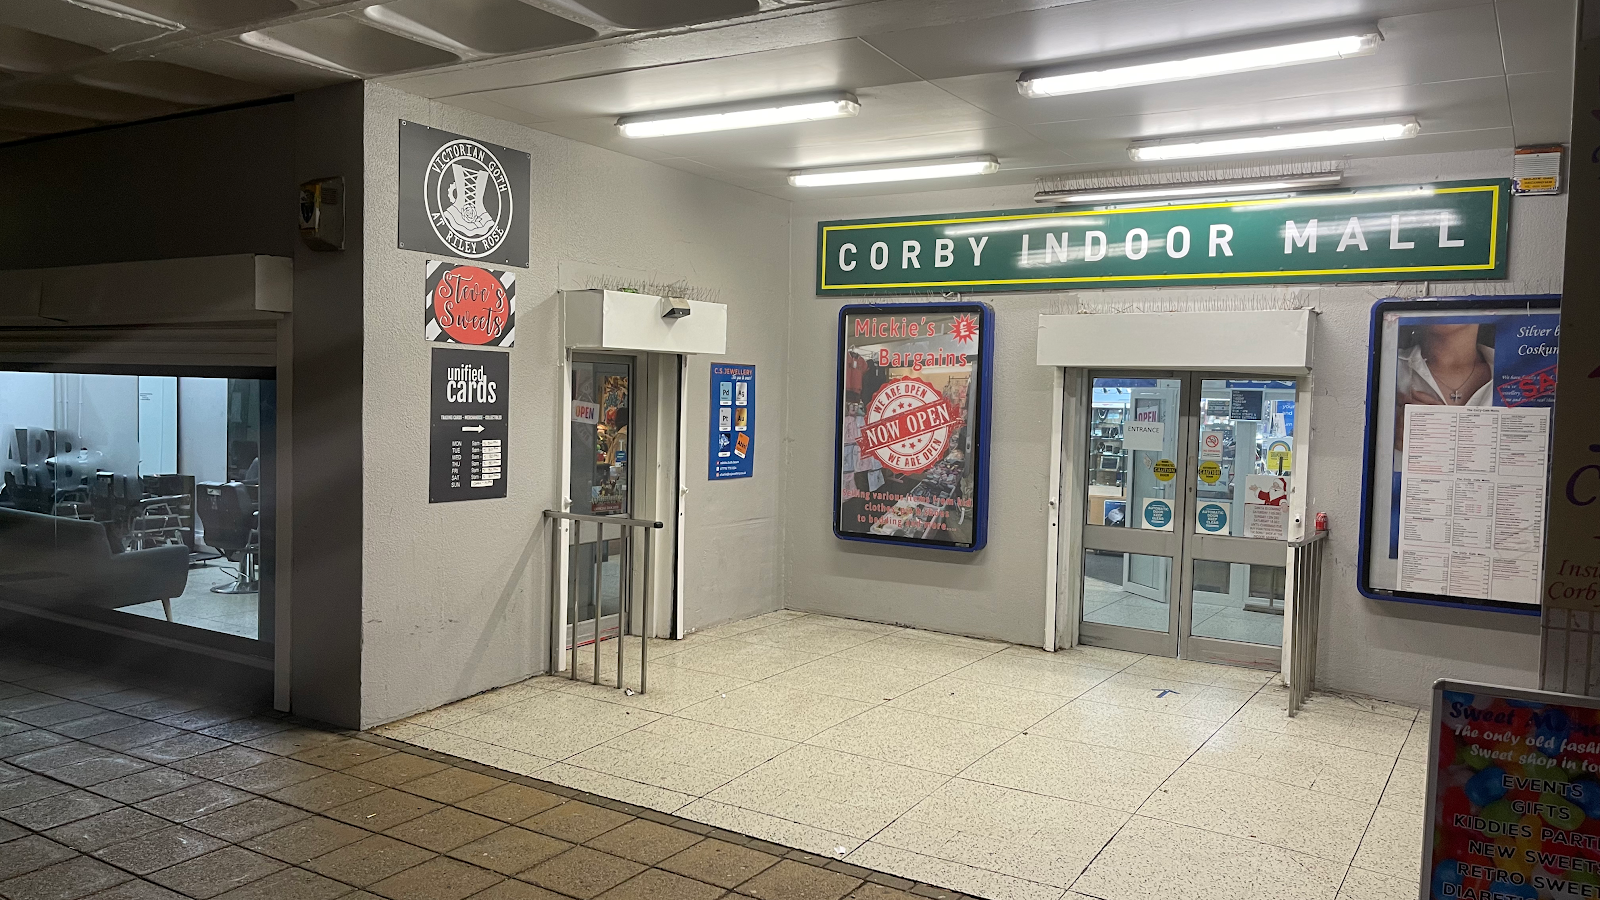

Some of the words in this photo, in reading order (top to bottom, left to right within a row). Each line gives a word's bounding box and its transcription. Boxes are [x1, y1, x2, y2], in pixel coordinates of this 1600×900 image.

[431, 143, 485, 174] VICTORIAN
[488, 161, 508, 192] GOTH
[431, 211, 446, 228] AT
[446, 230, 477, 254] RILEY
[483, 226, 504, 250] ROSE
[838, 236, 989, 272] CORBY
[1021, 223, 1234, 265] INDOOR
[1284, 211, 1465, 255] MALL
[438, 270, 506, 310] Steve's
[440, 301, 505, 337] Sweets
[854, 316, 936, 338] Mickie's
[1517, 325, 1552, 337] Silver
[878, 348, 968, 372] Bargains
[447, 364, 484, 381] unified
[1519, 368, 1557, 397] SA
[447, 375, 497, 403] cards
[873, 403, 885, 414] WE
[884, 385, 902, 400] ARE
[904, 384, 928, 399] OPEN
[576, 405, 595, 420] OPEN
[1138, 411, 1157, 423] OPEN
[866, 419, 900, 448] NOW
[906, 403, 950, 433] OPEN
[888, 452, 901, 466] WE
[904, 458, 921, 468] ARE
[923, 438, 942, 460] OPEN
[872, 491, 903, 501] various
[933, 495, 954, 505] from
[857, 514, 866, 523] to
[868, 515, 902, 529] bedding
[905, 519, 920, 528] and
[924, 507, 950, 517] shoes
[1557, 559, 1600, 578] Insi
[1548, 581, 1600, 607] Corb
[1450, 702, 1515, 726] Sweet
[1455, 724, 1479, 738] The
[1484, 731, 1521, 745] only
[1526, 736, 1555, 749] old
[1470, 744, 1513, 761] Sweet
[1518, 752, 1557, 769] shop
[1561, 757, 1576, 771] in
[1582, 758, 1600, 773] to
[1502, 775, 1584, 798] EVENTS
[1512, 801, 1570, 820] GIFTS
[1454, 814, 1533, 838] KIDDIES
[1469, 840, 1515, 859] NEW
[1457, 862, 1525, 885] RETRO
